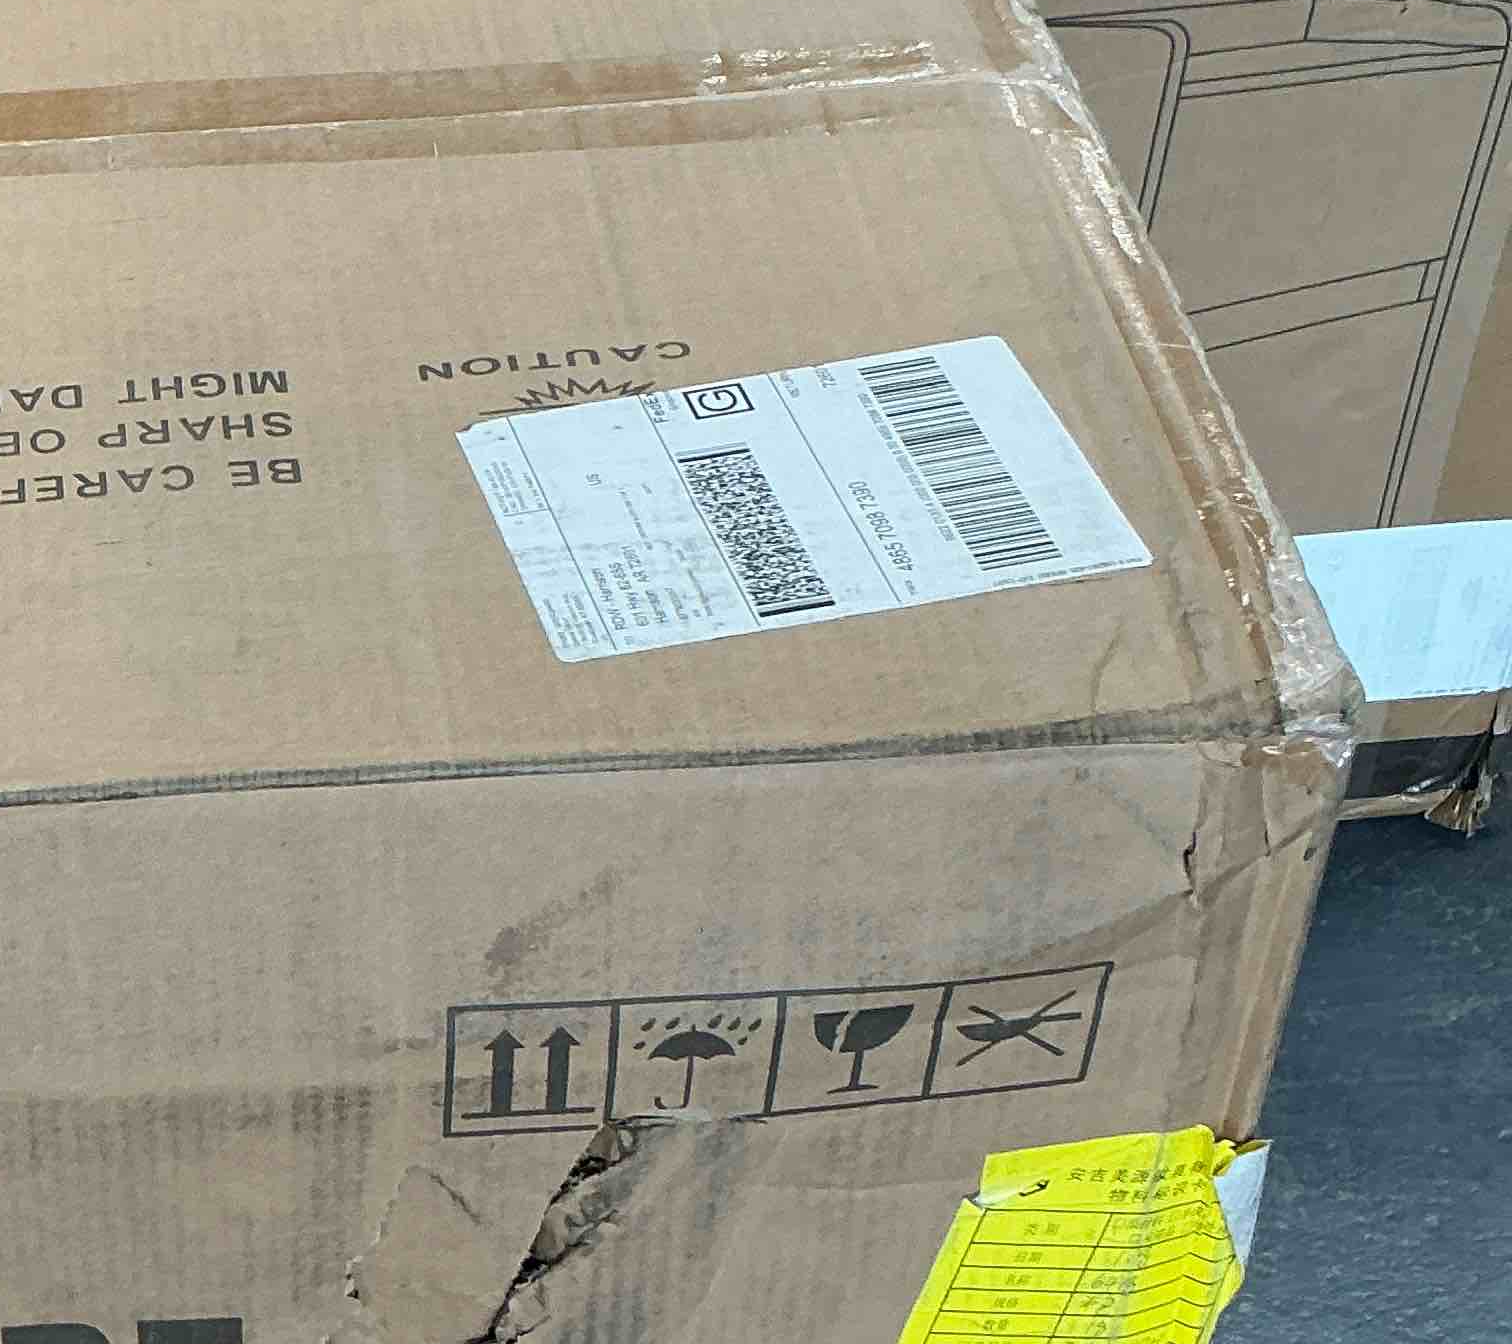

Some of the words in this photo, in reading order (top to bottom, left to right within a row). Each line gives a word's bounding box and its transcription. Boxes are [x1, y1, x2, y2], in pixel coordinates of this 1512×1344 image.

[418, 341, 692, 384] CAUTION
[115, 369, 290, 408] MIGHT
[697, 388, 739, 413] G
[94, 411, 293, 449] SHARP
[229, 458, 302, 492] BE
[865, 511, 897, 541] 7098
[884, 541, 913, 571] 4865
